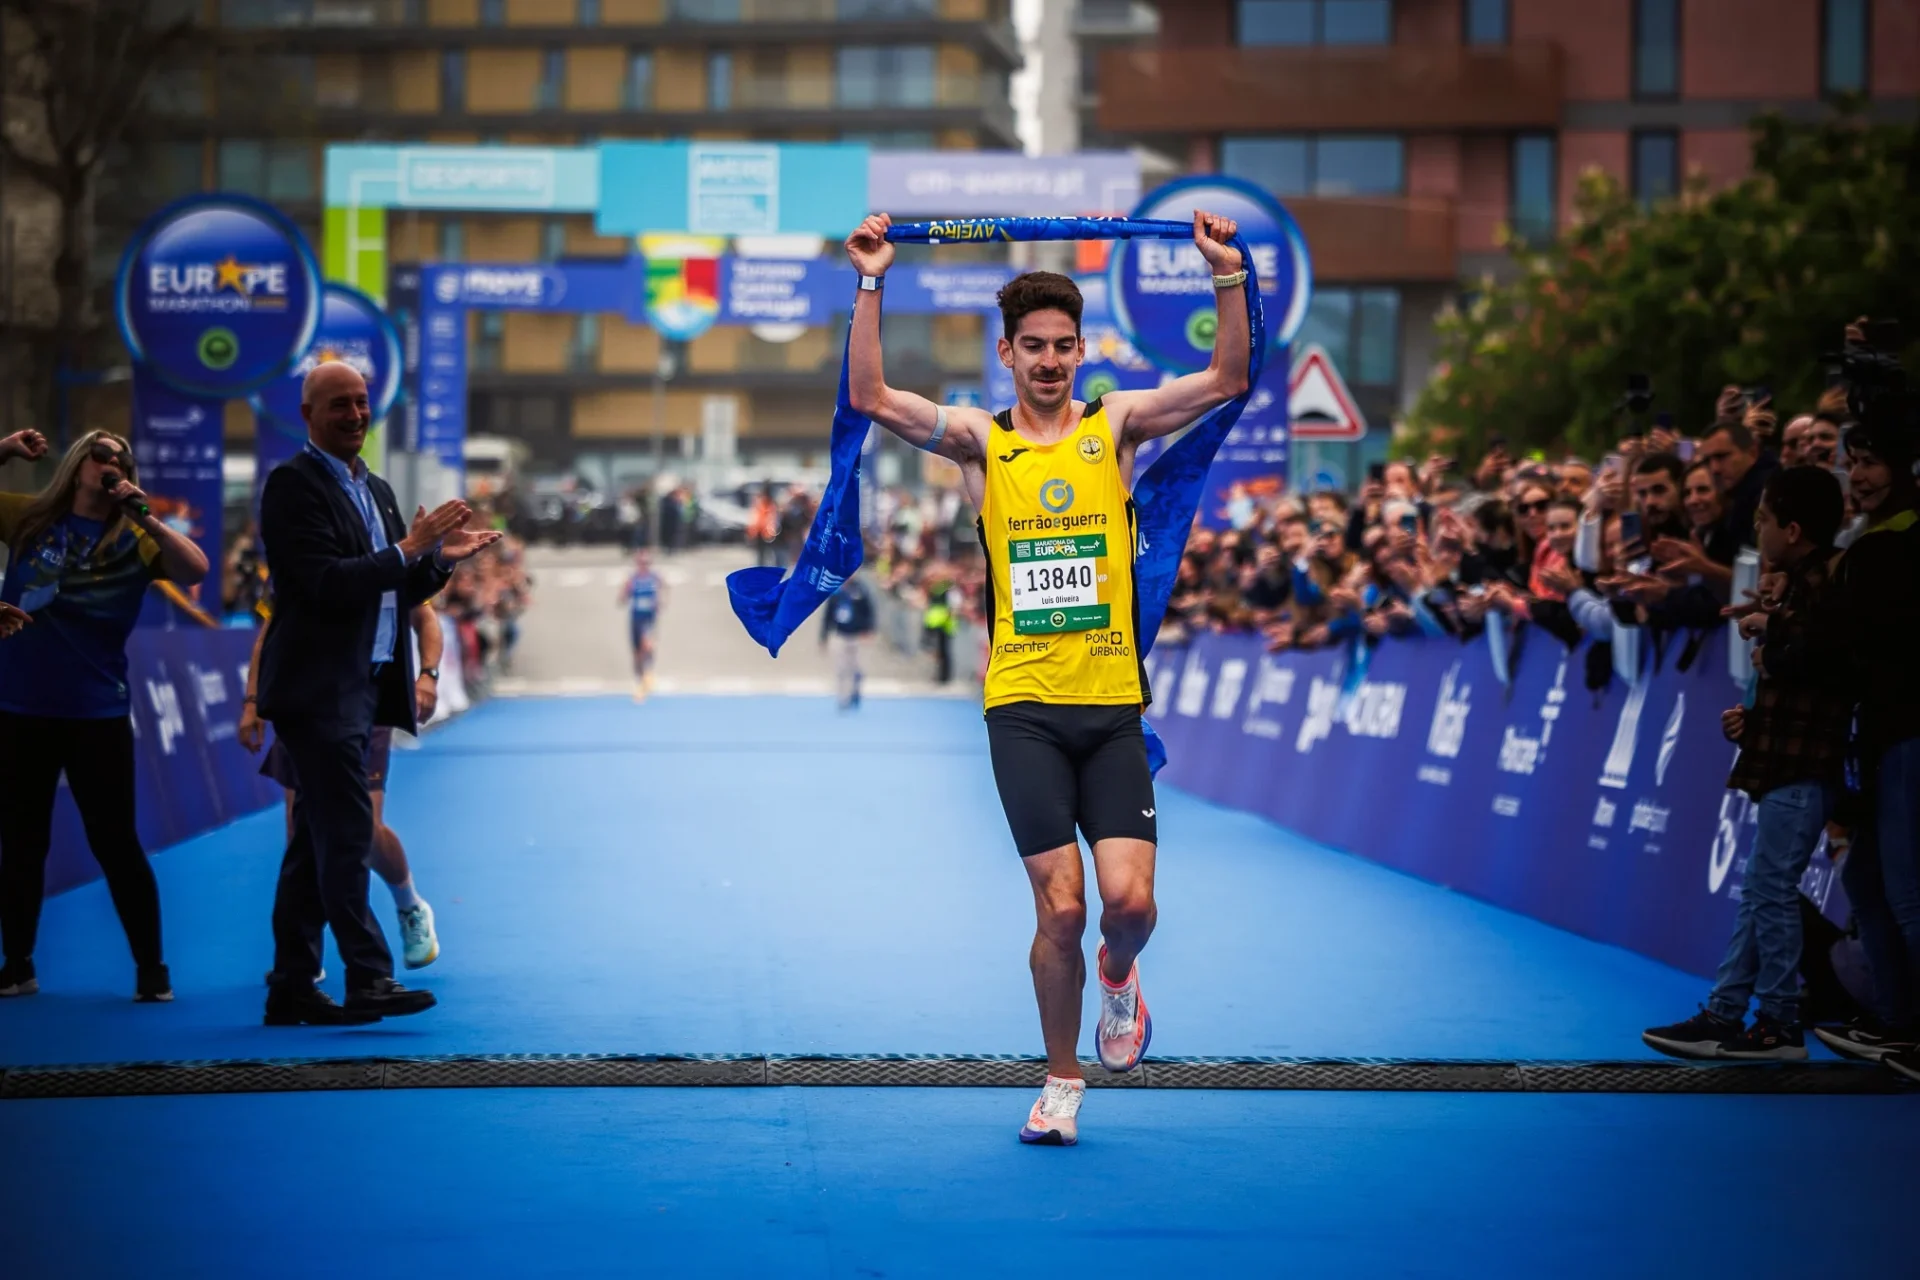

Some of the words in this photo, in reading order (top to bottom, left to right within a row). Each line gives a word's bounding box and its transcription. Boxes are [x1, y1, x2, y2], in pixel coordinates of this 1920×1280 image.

[1027, 565, 1092, 592] 13840
[1097, 574, 1108, 583] VIP
[1041, 596, 1055, 605] Luis
[1055, 594, 1080, 604] Oliveira
[1090, 646, 1130, 656] URBANO
